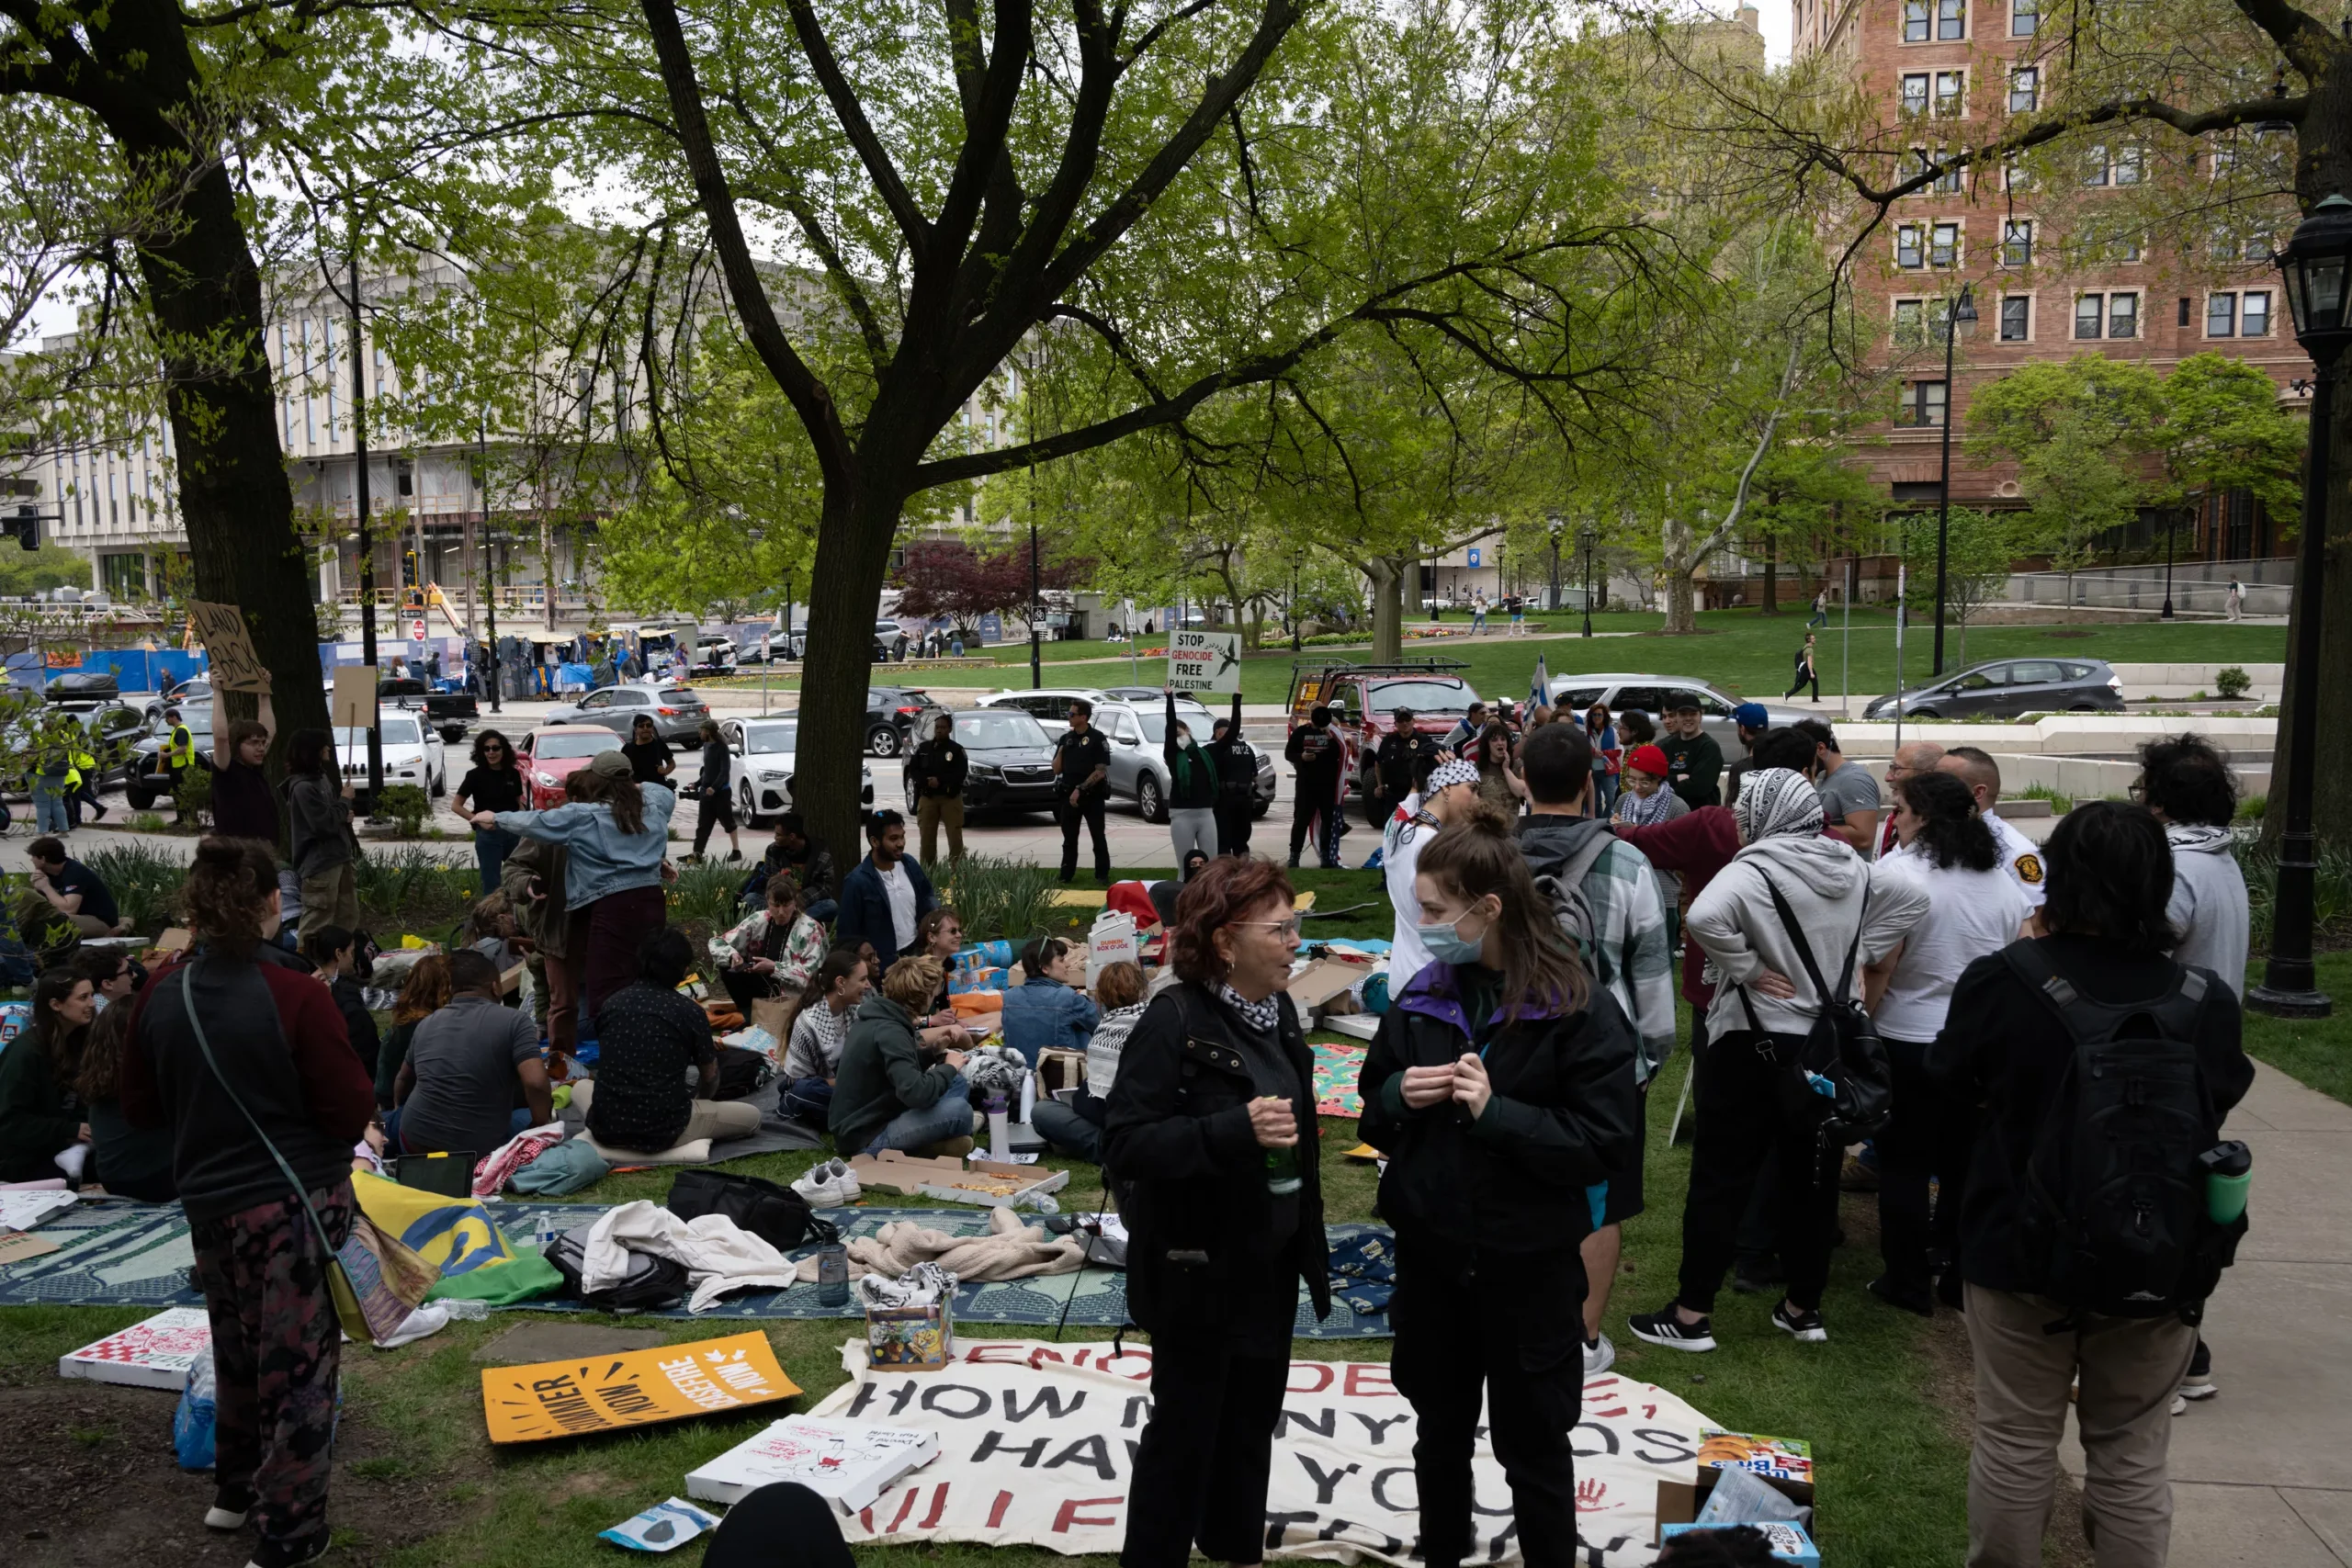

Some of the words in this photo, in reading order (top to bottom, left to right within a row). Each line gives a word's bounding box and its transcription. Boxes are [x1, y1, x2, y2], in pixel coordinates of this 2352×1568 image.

[195, 605, 241, 637] LAND
[1171, 649, 1213, 661] GENOCIDE
[1178, 634, 1204, 647] STOP
[211, 640, 269, 684] BACK
[1176, 663, 1203, 676] FREE
[1169, 679, 1213, 691] PALESTINE
[713, 1361, 769, 1391] NOW
[594, 1382, 654, 1416] NOW
[845, 1379, 1088, 1423] HOW
